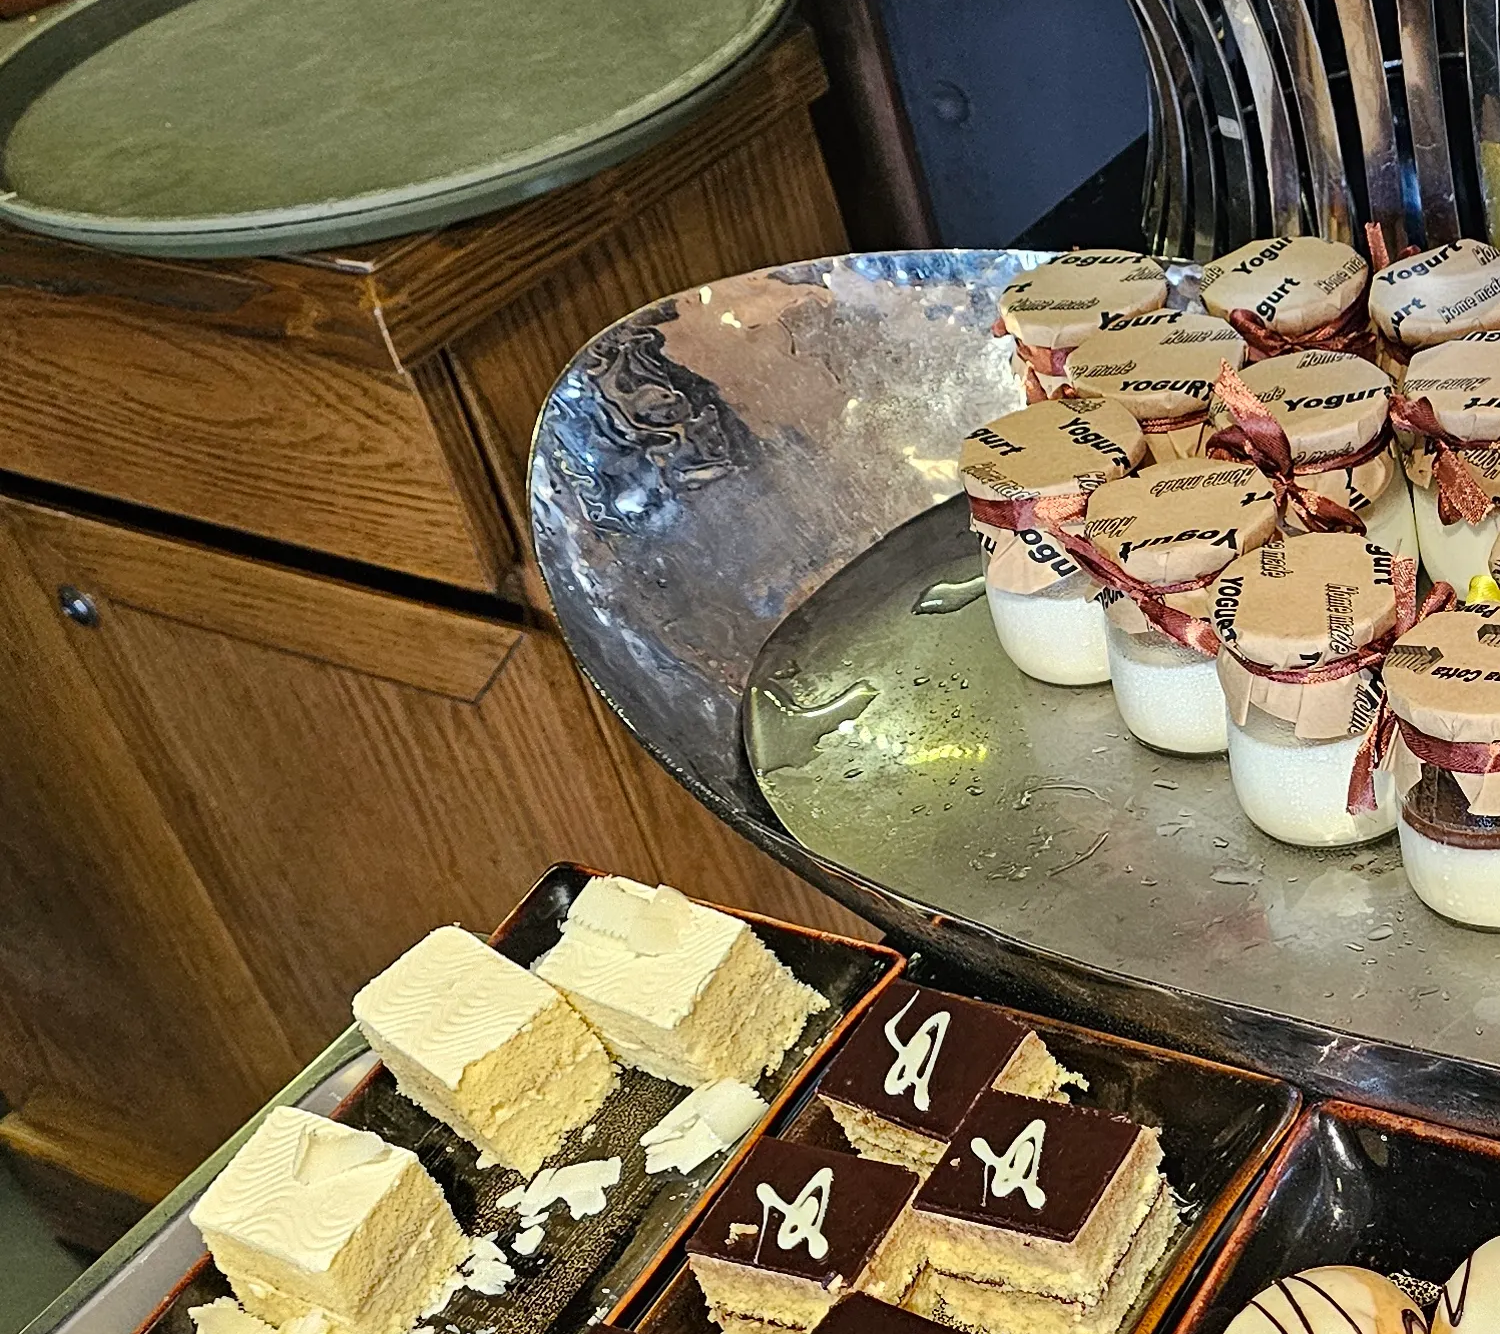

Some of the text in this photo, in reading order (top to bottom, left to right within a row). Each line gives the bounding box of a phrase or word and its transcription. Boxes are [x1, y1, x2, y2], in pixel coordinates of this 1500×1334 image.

[1231, 236, 1294, 275] Yogur
[1376, 243, 1463, 287] Yogurt
[1256, 276, 1301, 323] gurt
[1437, 292, 1478, 325] Home
[1098, 310, 1183, 332] Ygurt
[1254, 385, 1286, 404] ade
[966, 427, 1027, 457] gurt
[1150, 466, 1259, 498] Home made
[1019, 528, 1079, 578] ogu
[1119, 528, 1240, 564] Yogurt
[1260, 550, 1294, 579] made
[1365, 543, 1394, 586] gurt
[1325, 582, 1360, 655] Home made
[1386, 646, 1443, 675] Pann
[1431, 666, 1483, 682] Cotta
